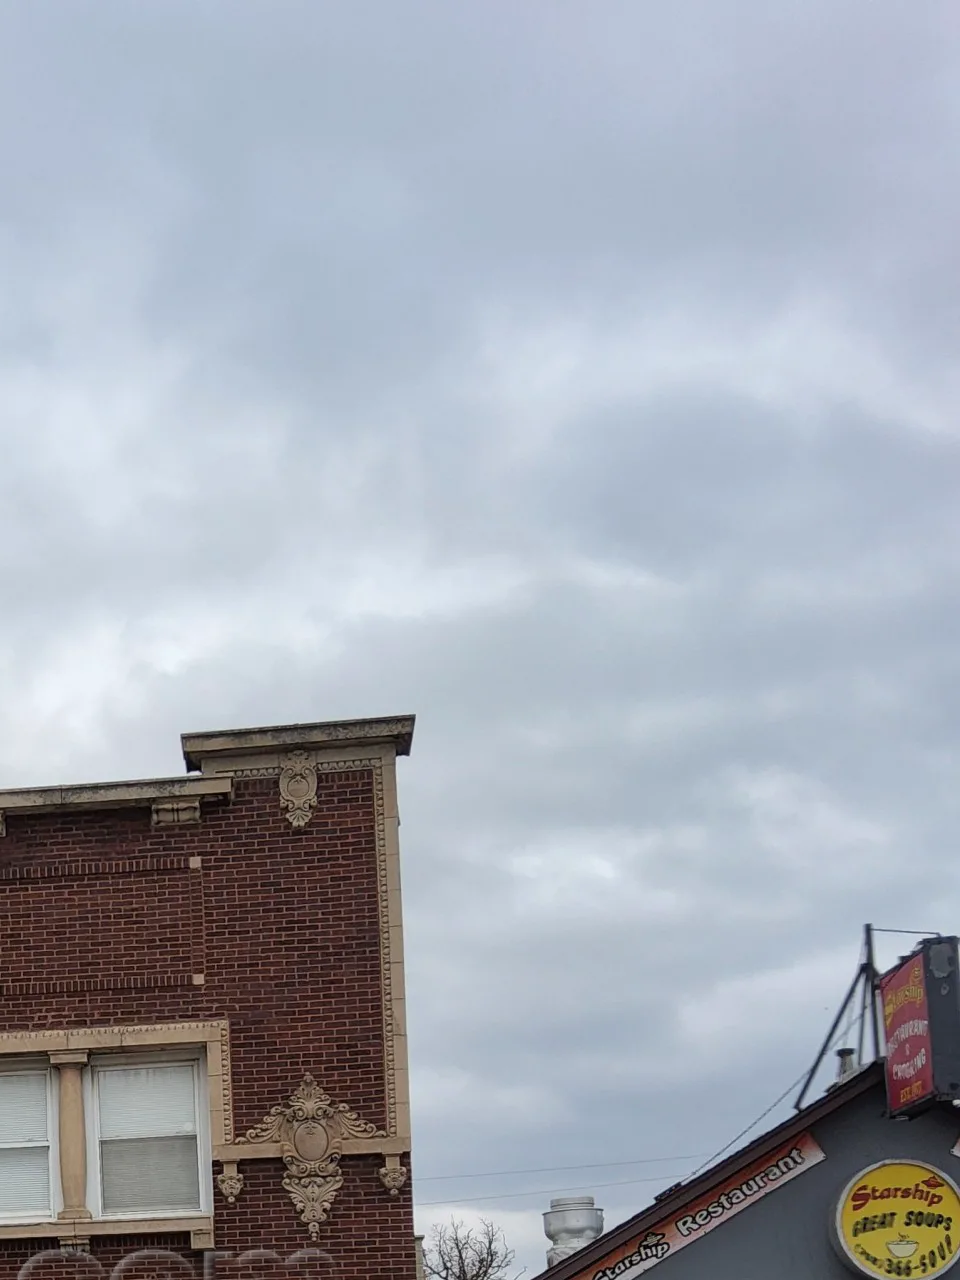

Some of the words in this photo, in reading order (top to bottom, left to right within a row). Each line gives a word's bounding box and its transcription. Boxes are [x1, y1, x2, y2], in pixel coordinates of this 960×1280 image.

[675, 1148, 806, 1237] Restaurant
[851, 1183, 943, 1211] Starship
[904, 1211, 952, 1231] SOUPS
